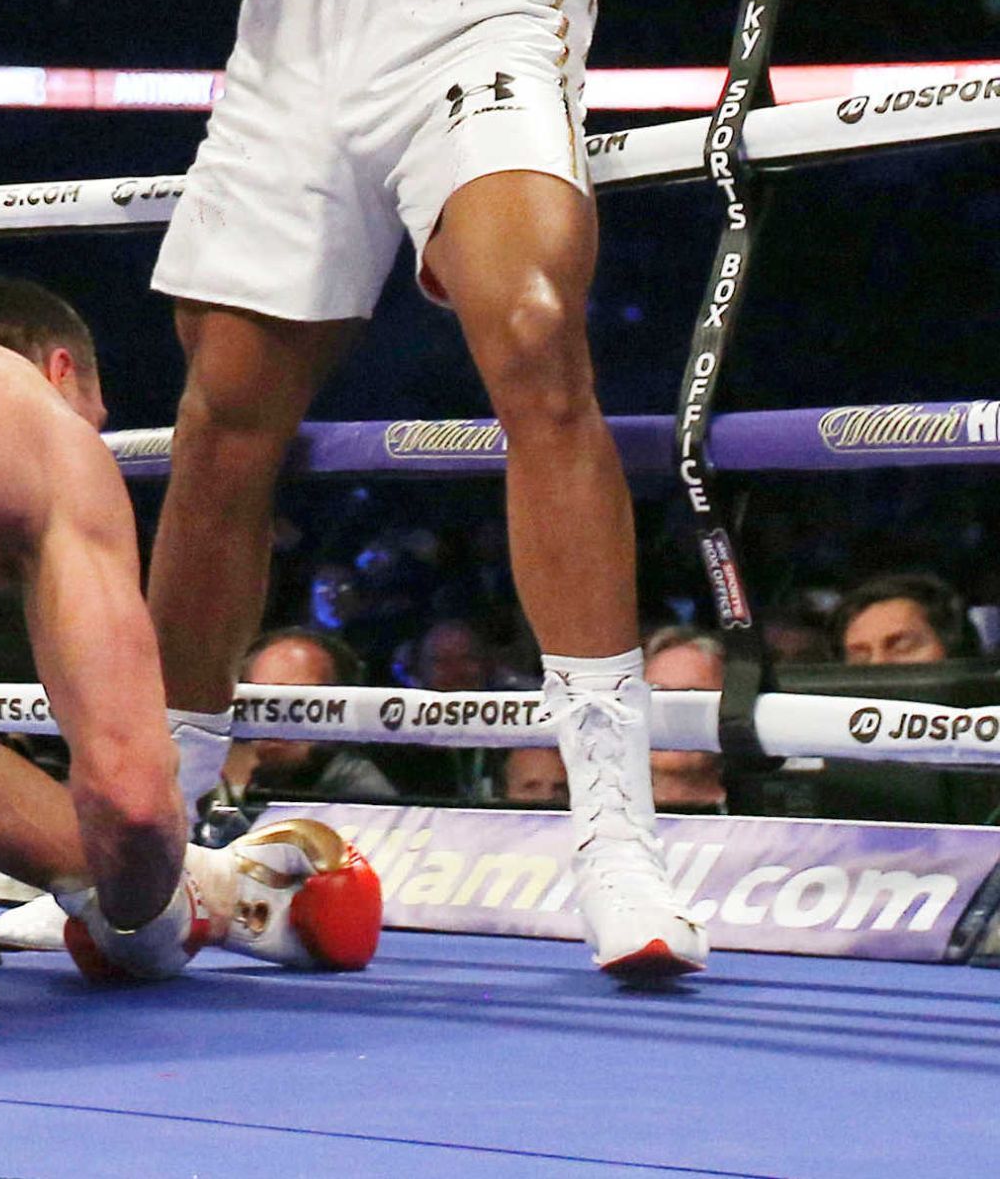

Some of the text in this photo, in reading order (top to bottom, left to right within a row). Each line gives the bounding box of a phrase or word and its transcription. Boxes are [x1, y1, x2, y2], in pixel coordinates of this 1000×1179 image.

[710, 79, 750, 230] SPORTS
[703, 252, 742, 328] BOX
[680, 352, 716, 512] OFFICE
[818, 404, 966, 447] William
